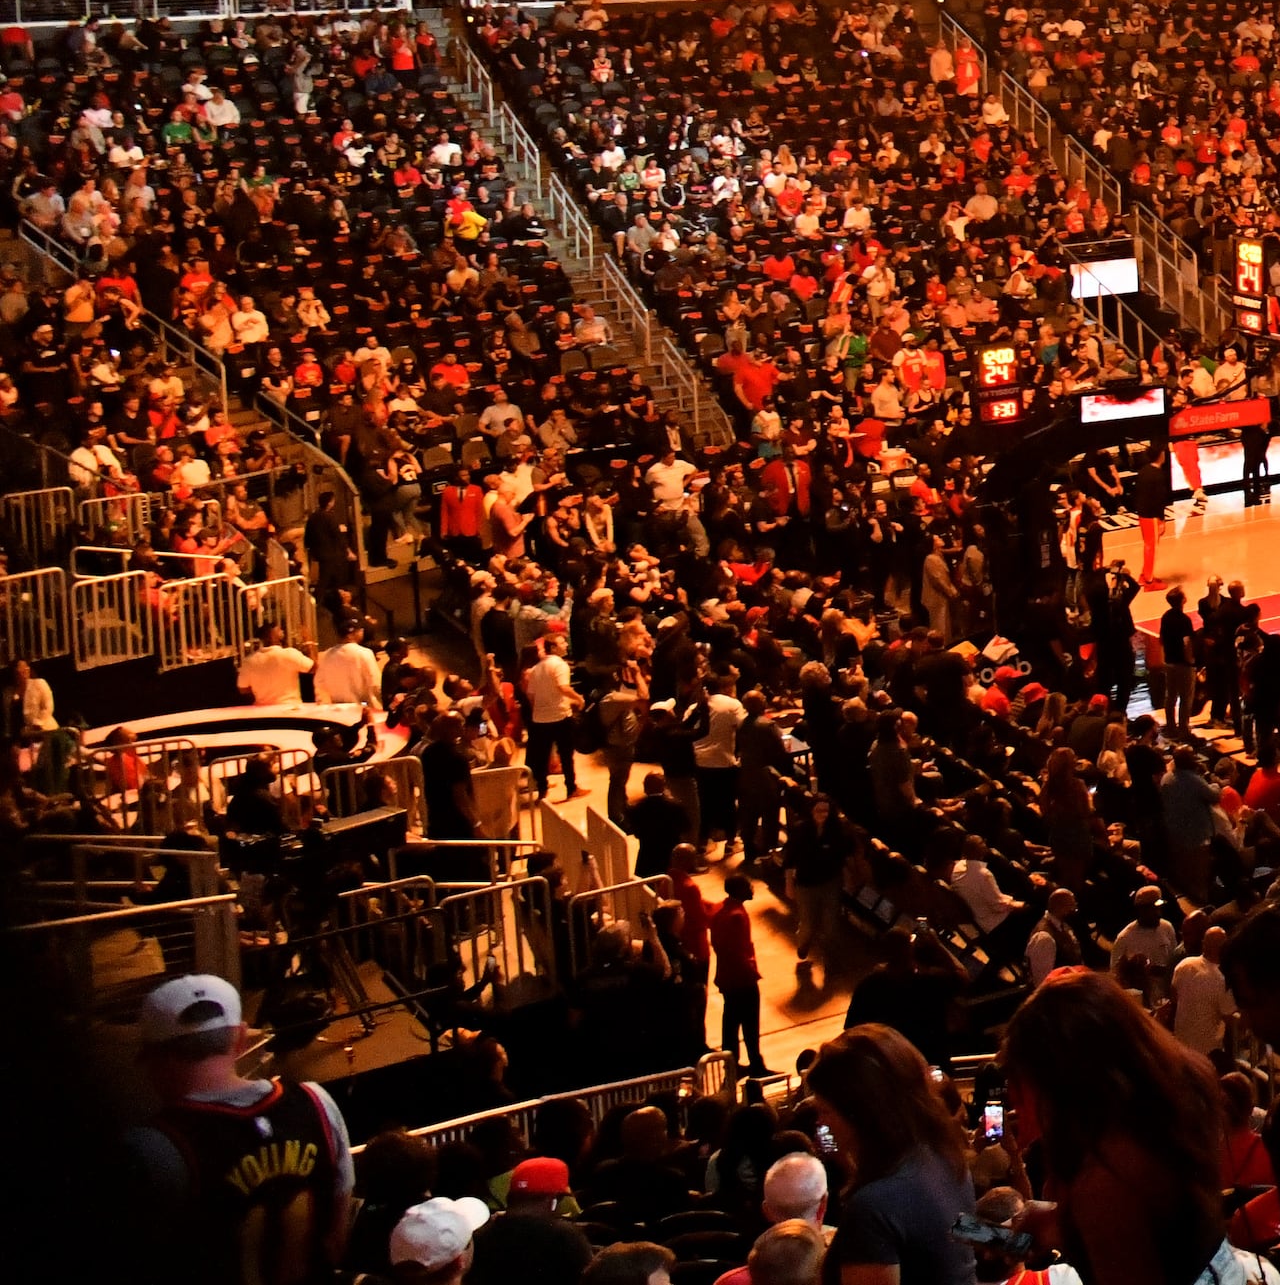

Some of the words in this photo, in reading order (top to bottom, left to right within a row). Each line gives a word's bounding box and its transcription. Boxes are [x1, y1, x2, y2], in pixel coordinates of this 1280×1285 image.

[1239, 261, 1260, 292] 24
[985, 364, 1009, 384] 24
[226, 1138, 318, 1195] YOUNG
